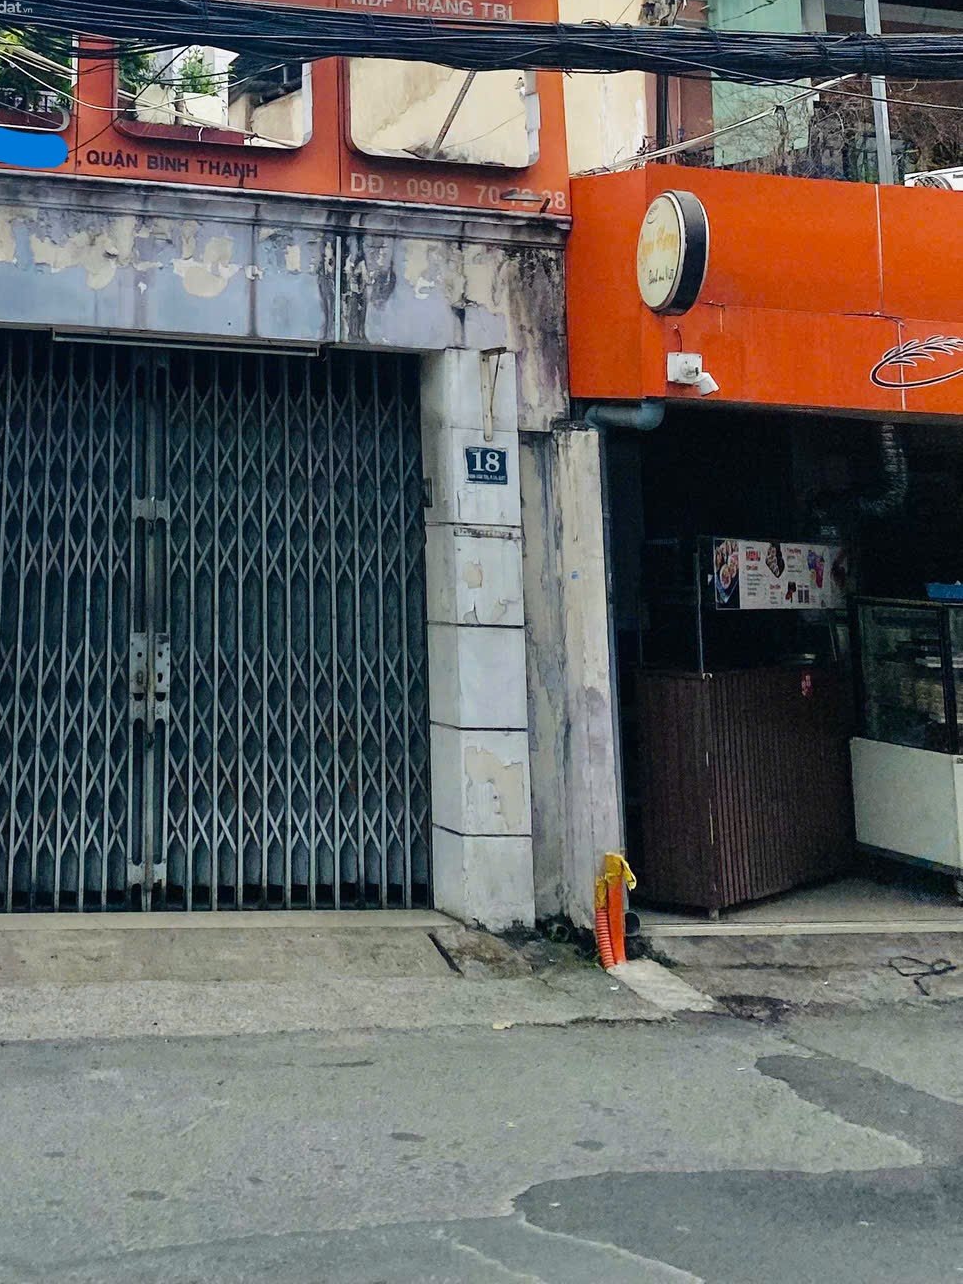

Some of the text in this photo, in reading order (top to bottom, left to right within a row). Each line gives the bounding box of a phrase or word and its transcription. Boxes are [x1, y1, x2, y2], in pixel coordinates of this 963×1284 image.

[480, 1, 514, 21] TRÍ
[86, 149, 259, 179] QUẬN BÌNH THẠNH
[406, 178, 459, 200] 0909
[472, 451, 502, 473] 18
